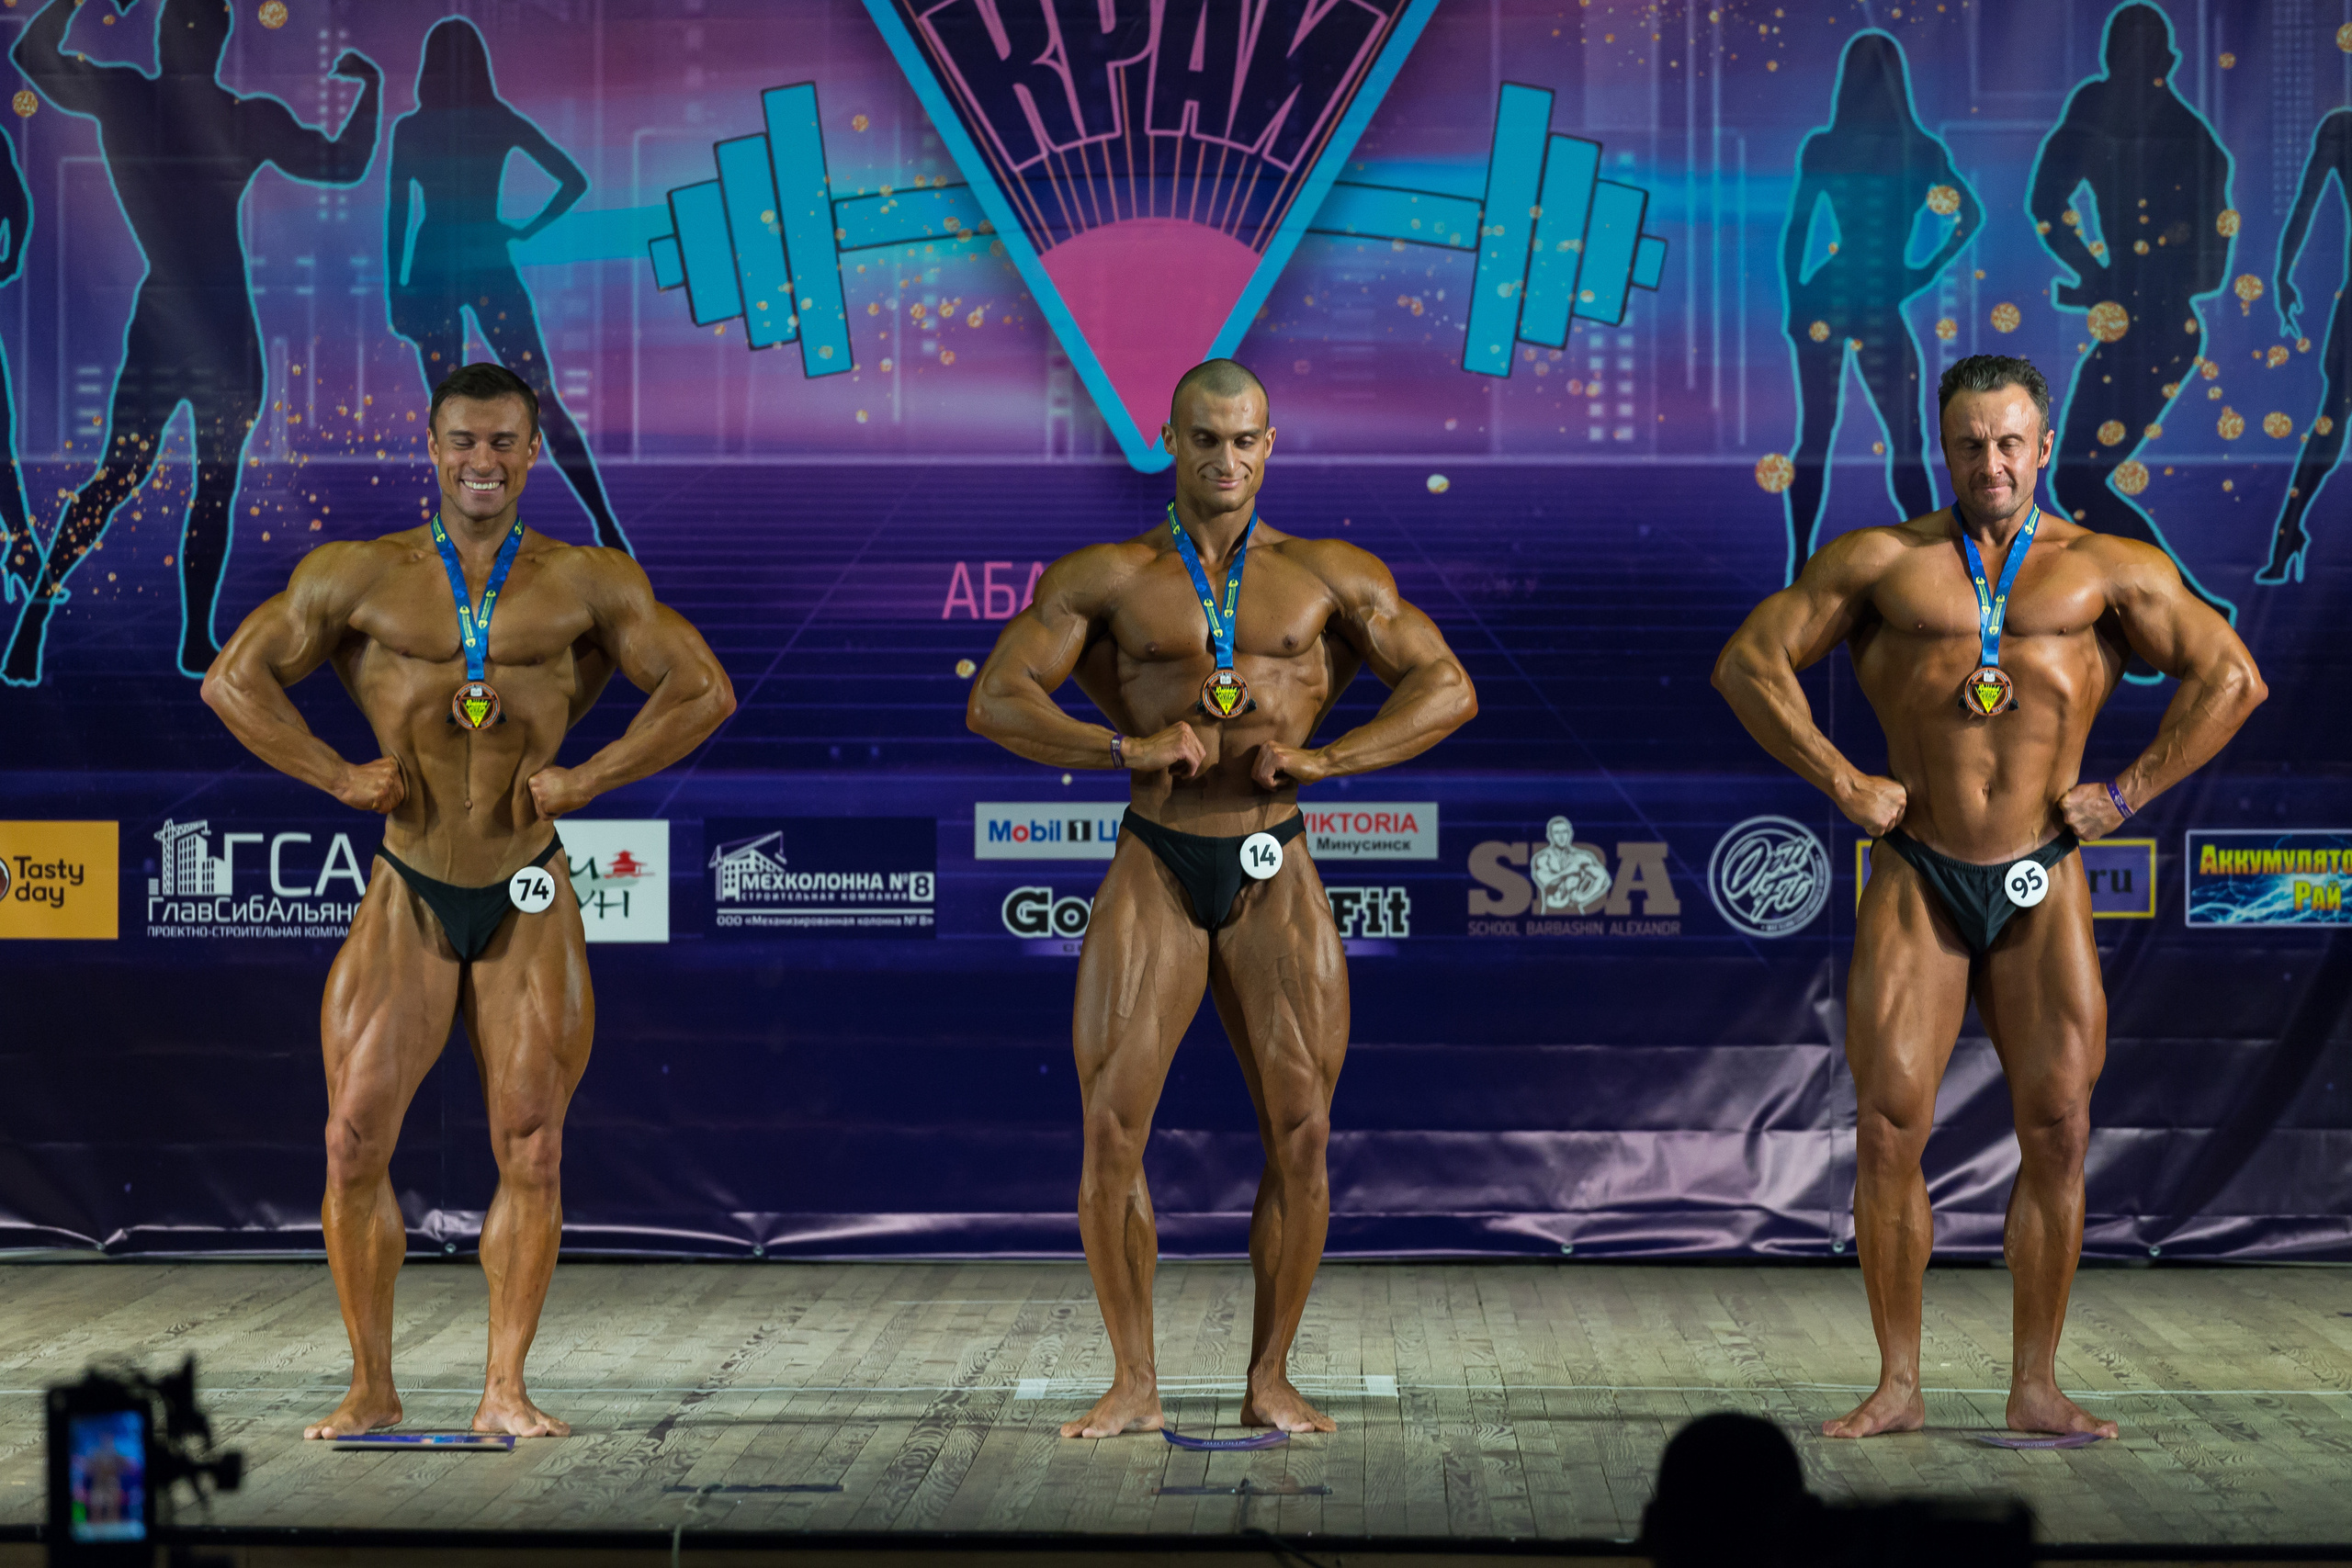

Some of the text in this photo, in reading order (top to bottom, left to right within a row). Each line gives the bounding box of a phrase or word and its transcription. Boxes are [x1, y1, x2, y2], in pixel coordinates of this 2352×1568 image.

[989, 819, 1060, 842] Mobil
[1304, 812, 1419, 834] VIKTORIA
[1250, 844, 1276, 867] 14
[1317, 837, 1410, 853] Минусинск
[13, 855, 84, 886] Tasty
[224, 832, 367, 897] ГСА
[517, 877, 548, 901] 74
[741, 874, 884, 891] МЕХКОЛОННА
[2011, 867, 2042, 899] 95
[15, 881, 64, 908] day
[1002, 886, 1410, 939] Go Fit
[147, 926, 348, 938] ПРОЕКТНО-СТРОИТЕЛЬНАЯ КОМПА
[1468, 921, 1520, 936] SCHOOL
[1526, 920, 1604, 935] BARBASHIN
